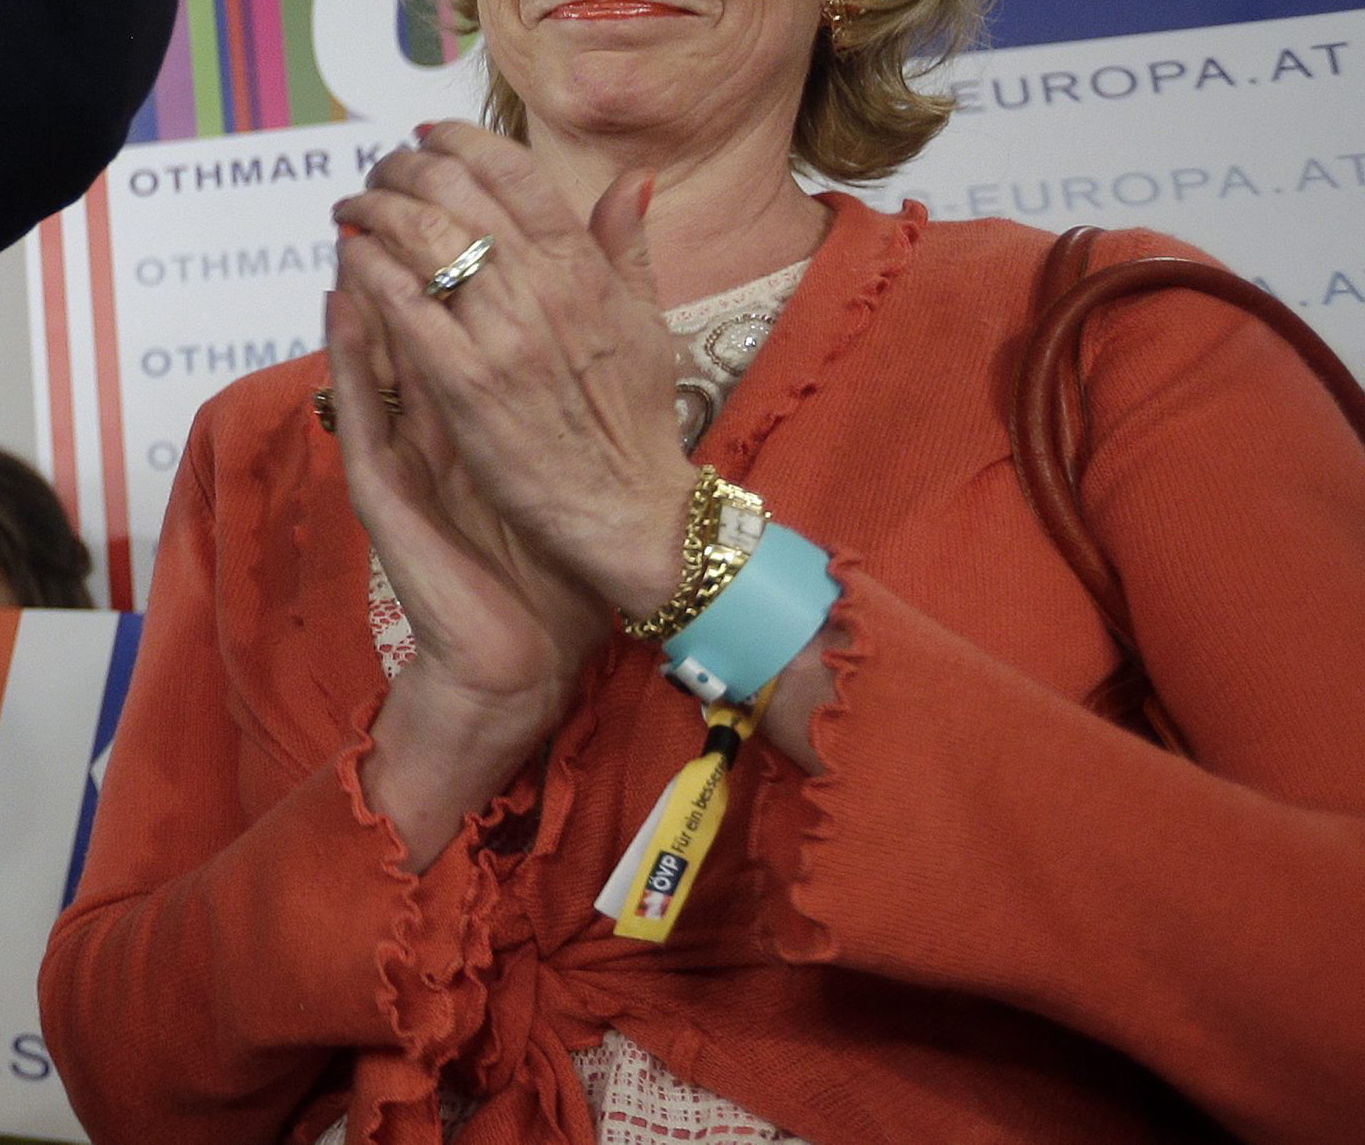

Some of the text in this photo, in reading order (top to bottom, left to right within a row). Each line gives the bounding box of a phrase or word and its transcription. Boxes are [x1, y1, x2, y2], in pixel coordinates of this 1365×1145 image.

[129, 149, 332, 198] OTHMAR
[649, 854, 681, 892] ÖVP
[671, 830, 693, 854] Für
[685, 808, 703, 832] ein
